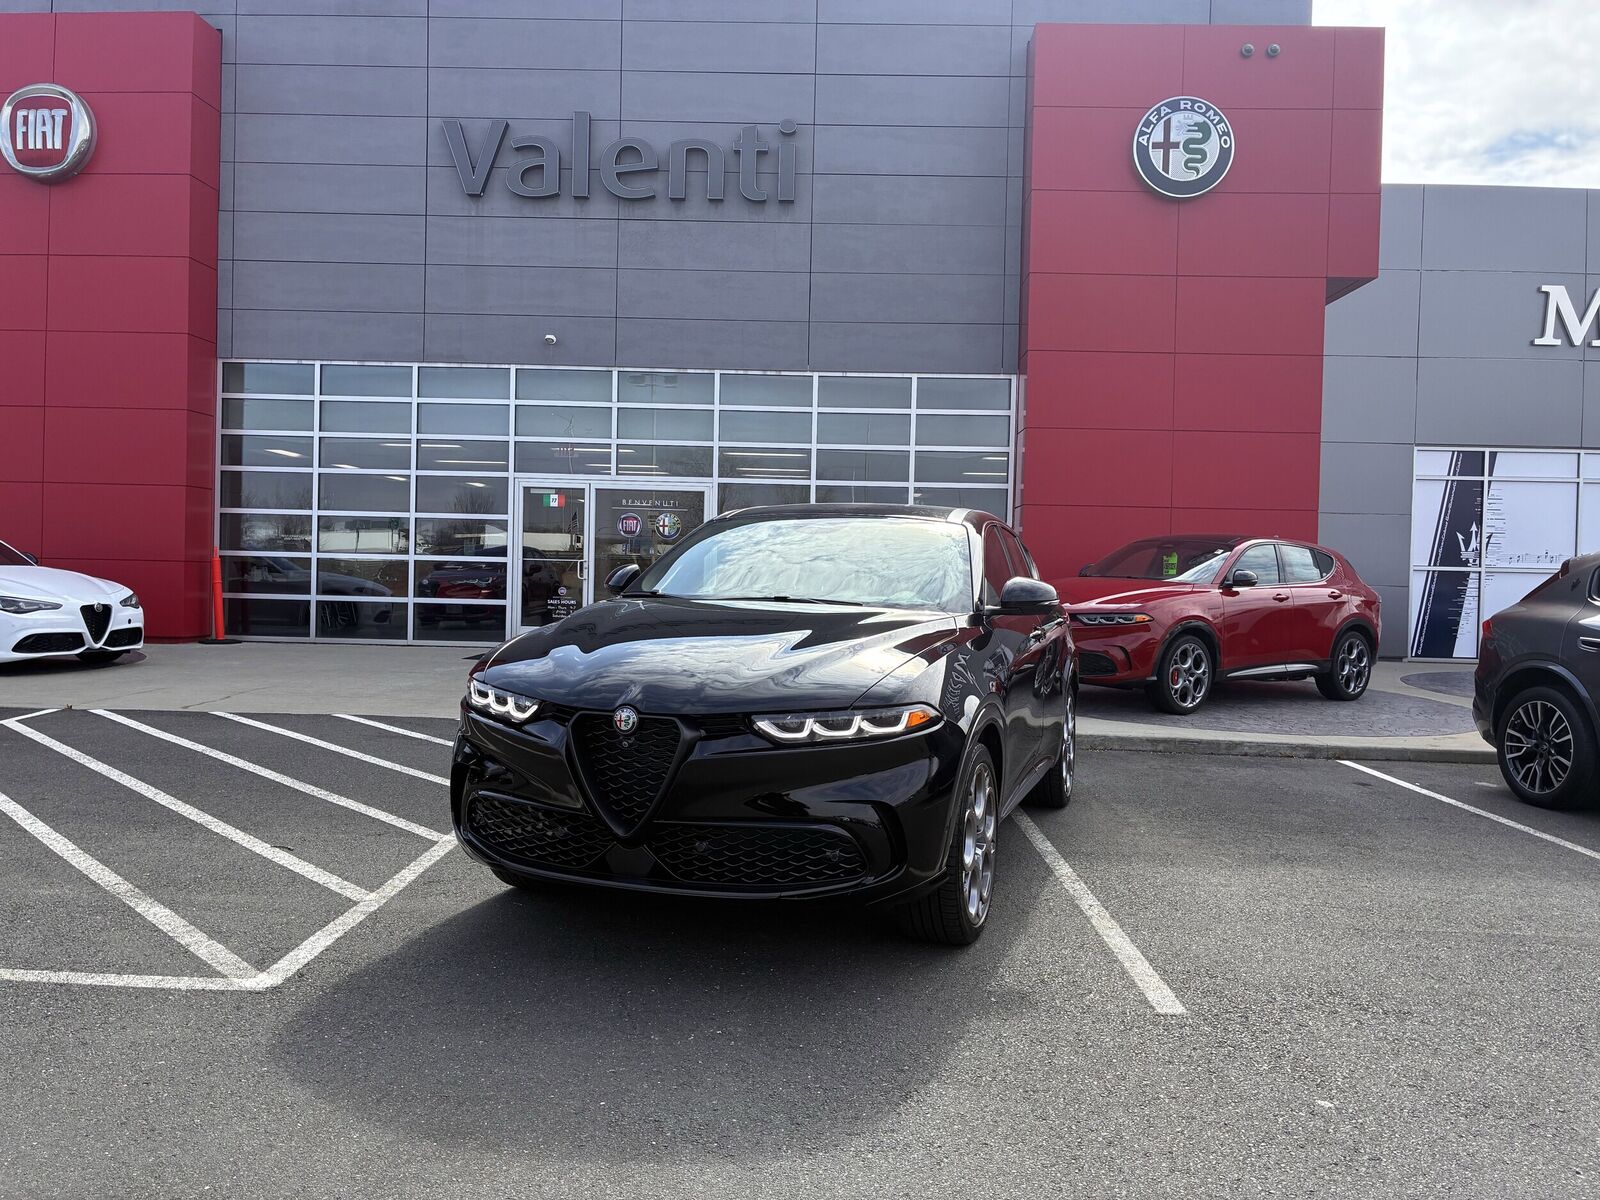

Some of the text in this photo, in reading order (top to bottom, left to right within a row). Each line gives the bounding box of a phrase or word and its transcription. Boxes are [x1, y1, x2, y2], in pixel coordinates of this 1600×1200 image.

[16, 108, 68, 150] FIAT
[1138, 100, 1231, 149] ALFA ROMEO
[442, 111, 798, 202] Valenti
[622, 499, 679, 507] BENVENUTI
[622, 520, 638, 532] FIAT
